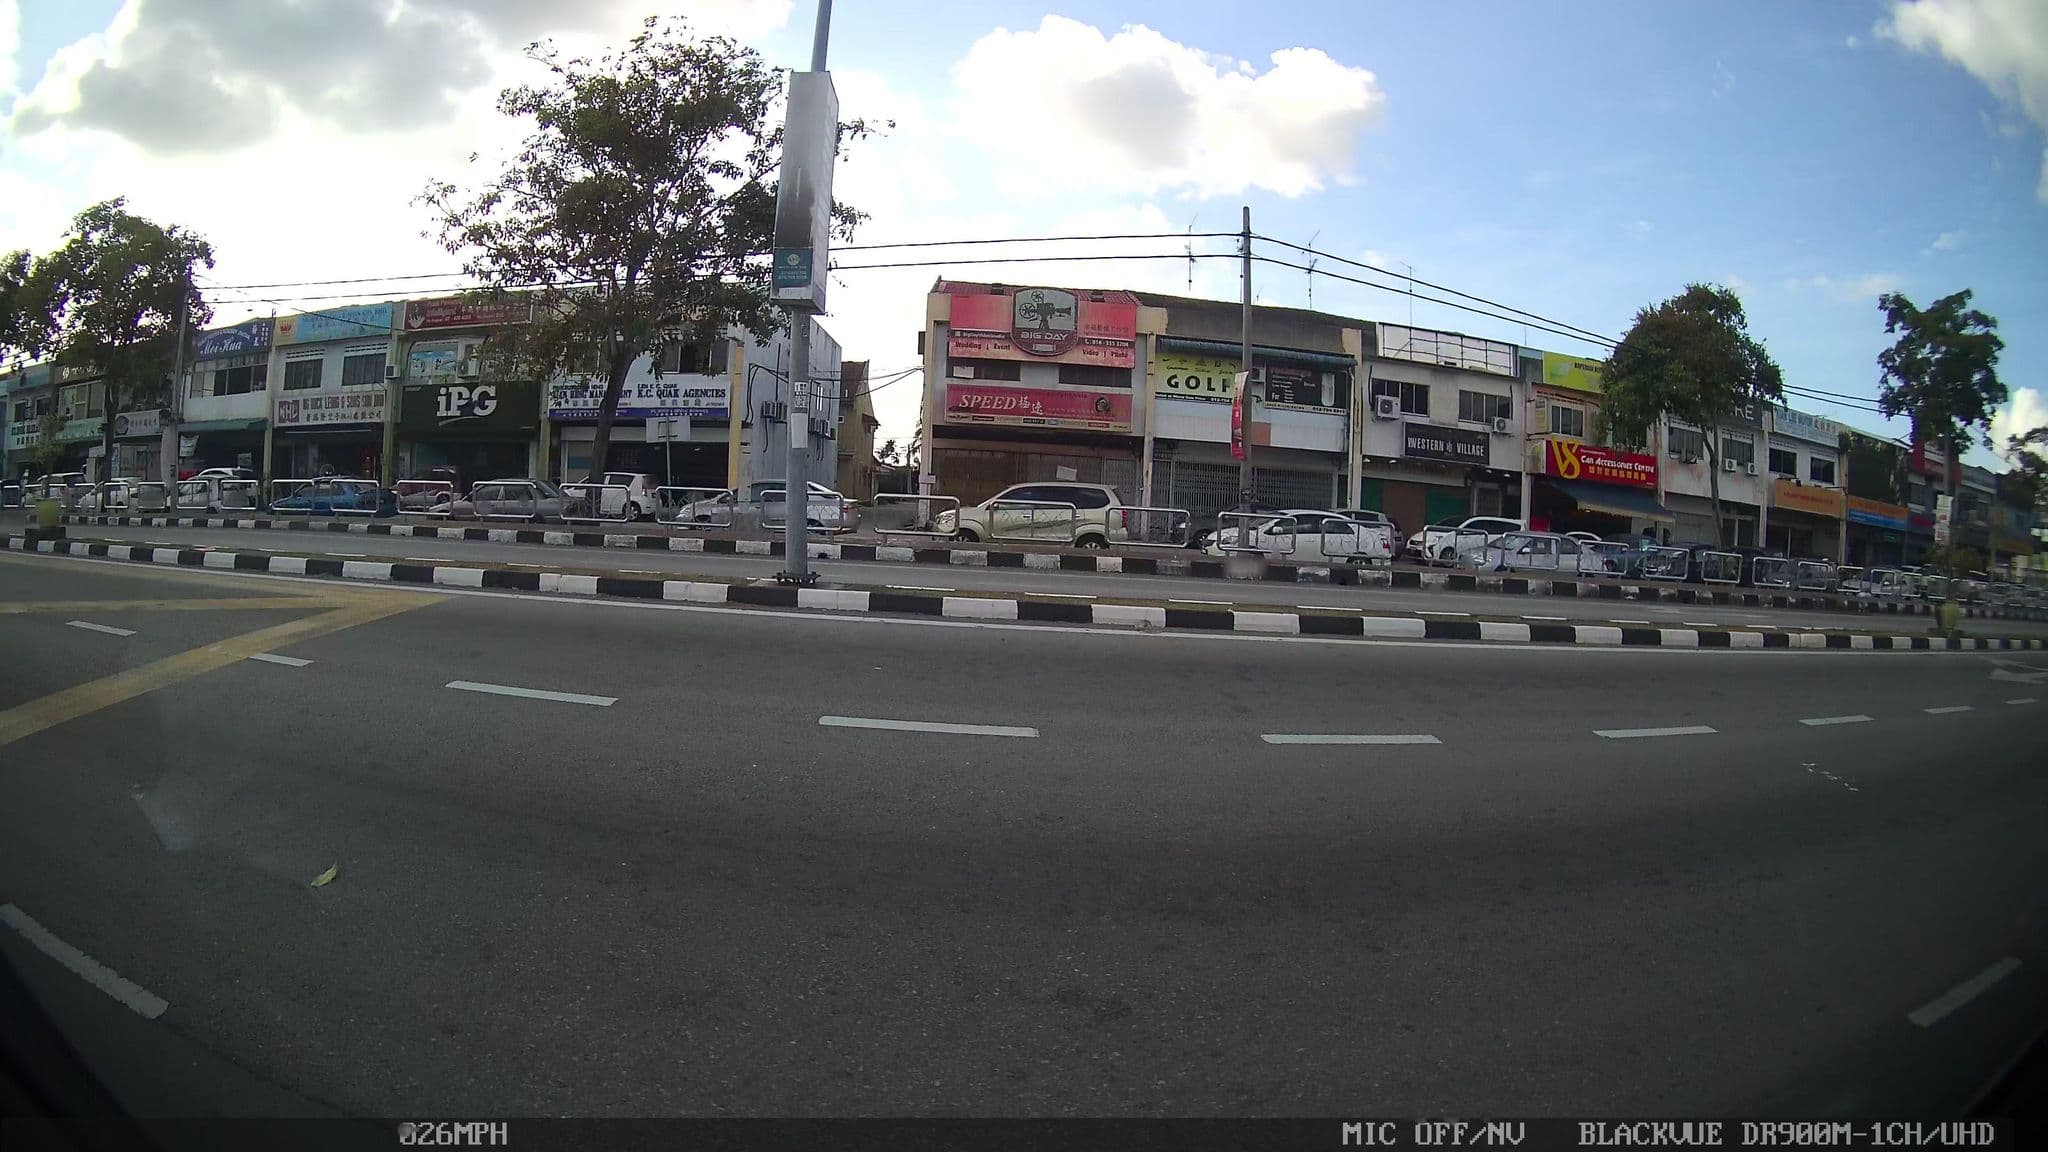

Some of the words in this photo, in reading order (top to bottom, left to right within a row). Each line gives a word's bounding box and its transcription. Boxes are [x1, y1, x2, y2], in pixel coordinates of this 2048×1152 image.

[1020, 331, 1043, 340] BIG
[1044, 332, 1069, 341] DAY
[1166, 374, 1231, 393] GOLF
[436, 385, 498, 417] iPG
[656, 388, 680, 399] QUAK
[683, 388, 726, 398] AGENCIES
[959, 394, 1017, 410] SPEED
[1407, 437, 1444, 452] WESTERN
[1456, 442, 1485, 457] VILLAGE
